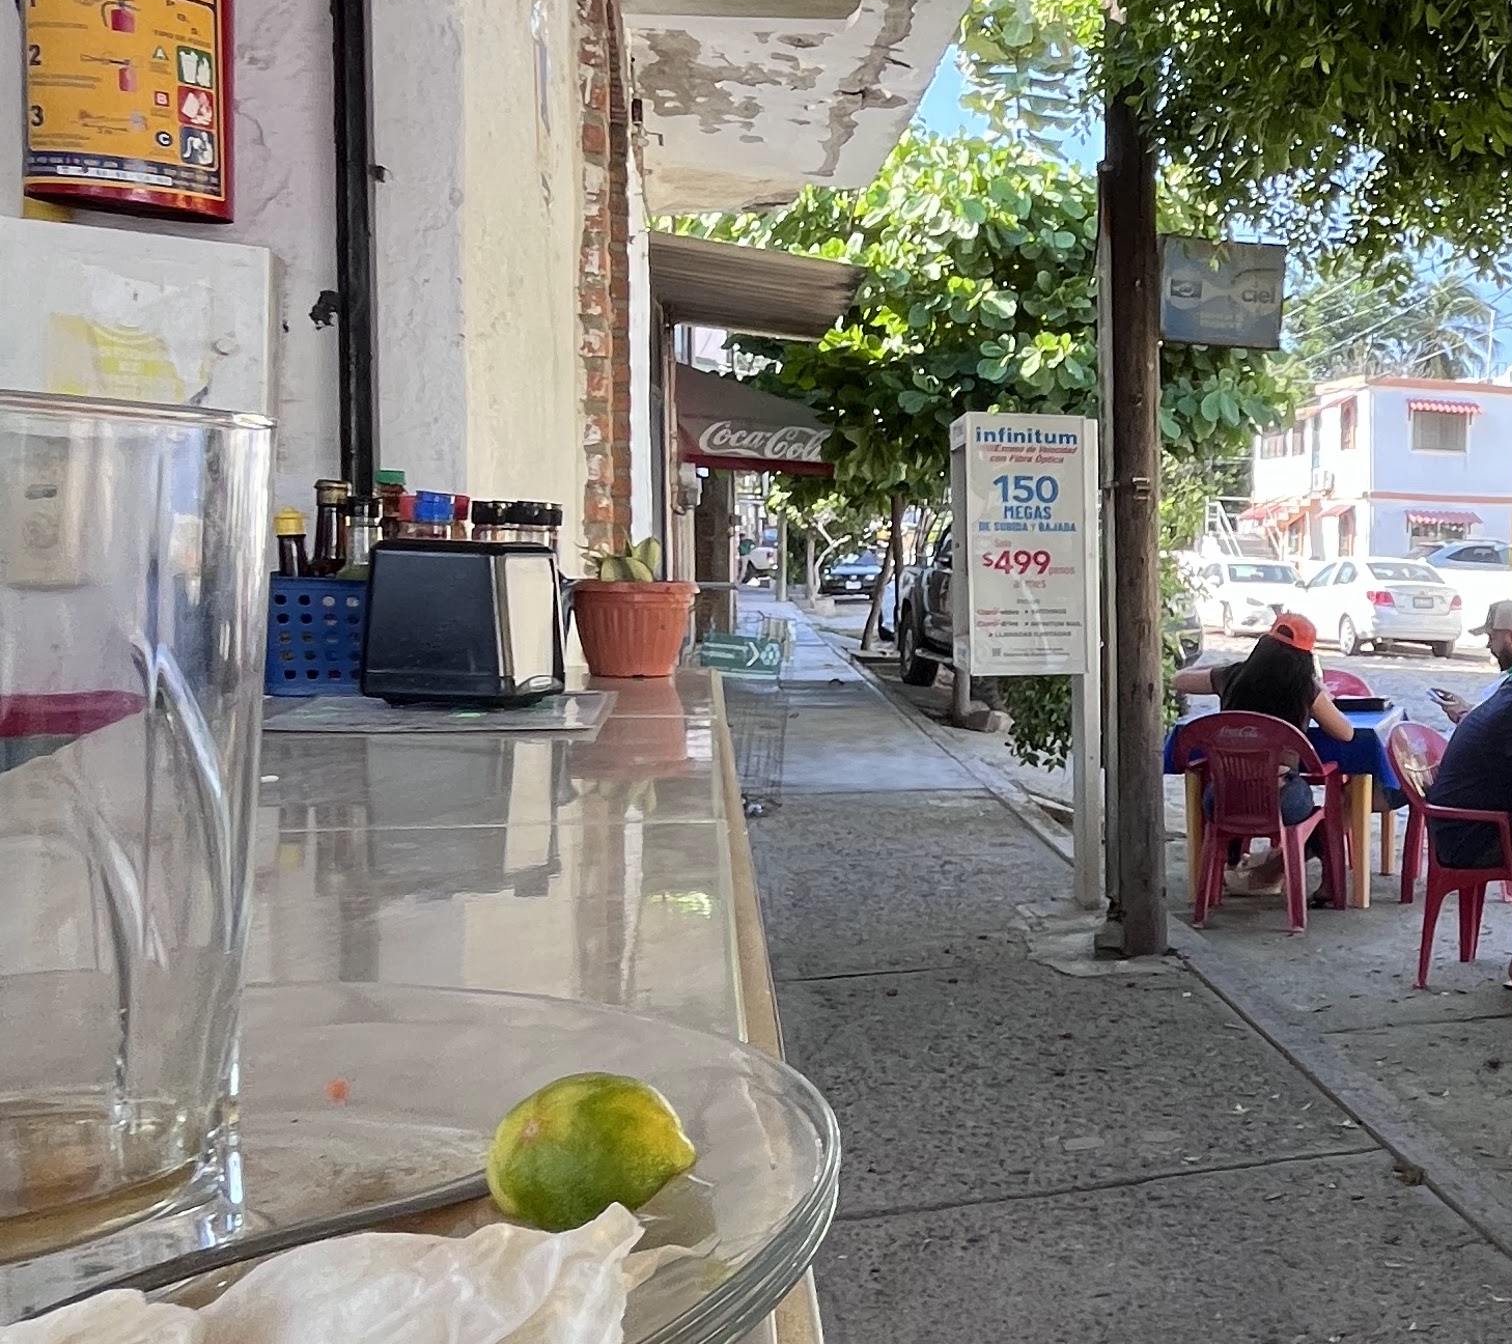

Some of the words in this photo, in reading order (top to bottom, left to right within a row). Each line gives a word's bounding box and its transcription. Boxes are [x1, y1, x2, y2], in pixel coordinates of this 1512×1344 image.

[28, 44, 42, 66] 2
[156, 93, 168, 105] B
[30, 105, 44, 127] 3
[157, 132, 170, 146] C
[1241, 285, 1276, 304] ciel
[975, 426, 1078, 445] infinitum
[993, 474, 1059, 504] 150
[1003, 505, 1053, 520] MEGAS
[982, 550, 1051, 575] $499
